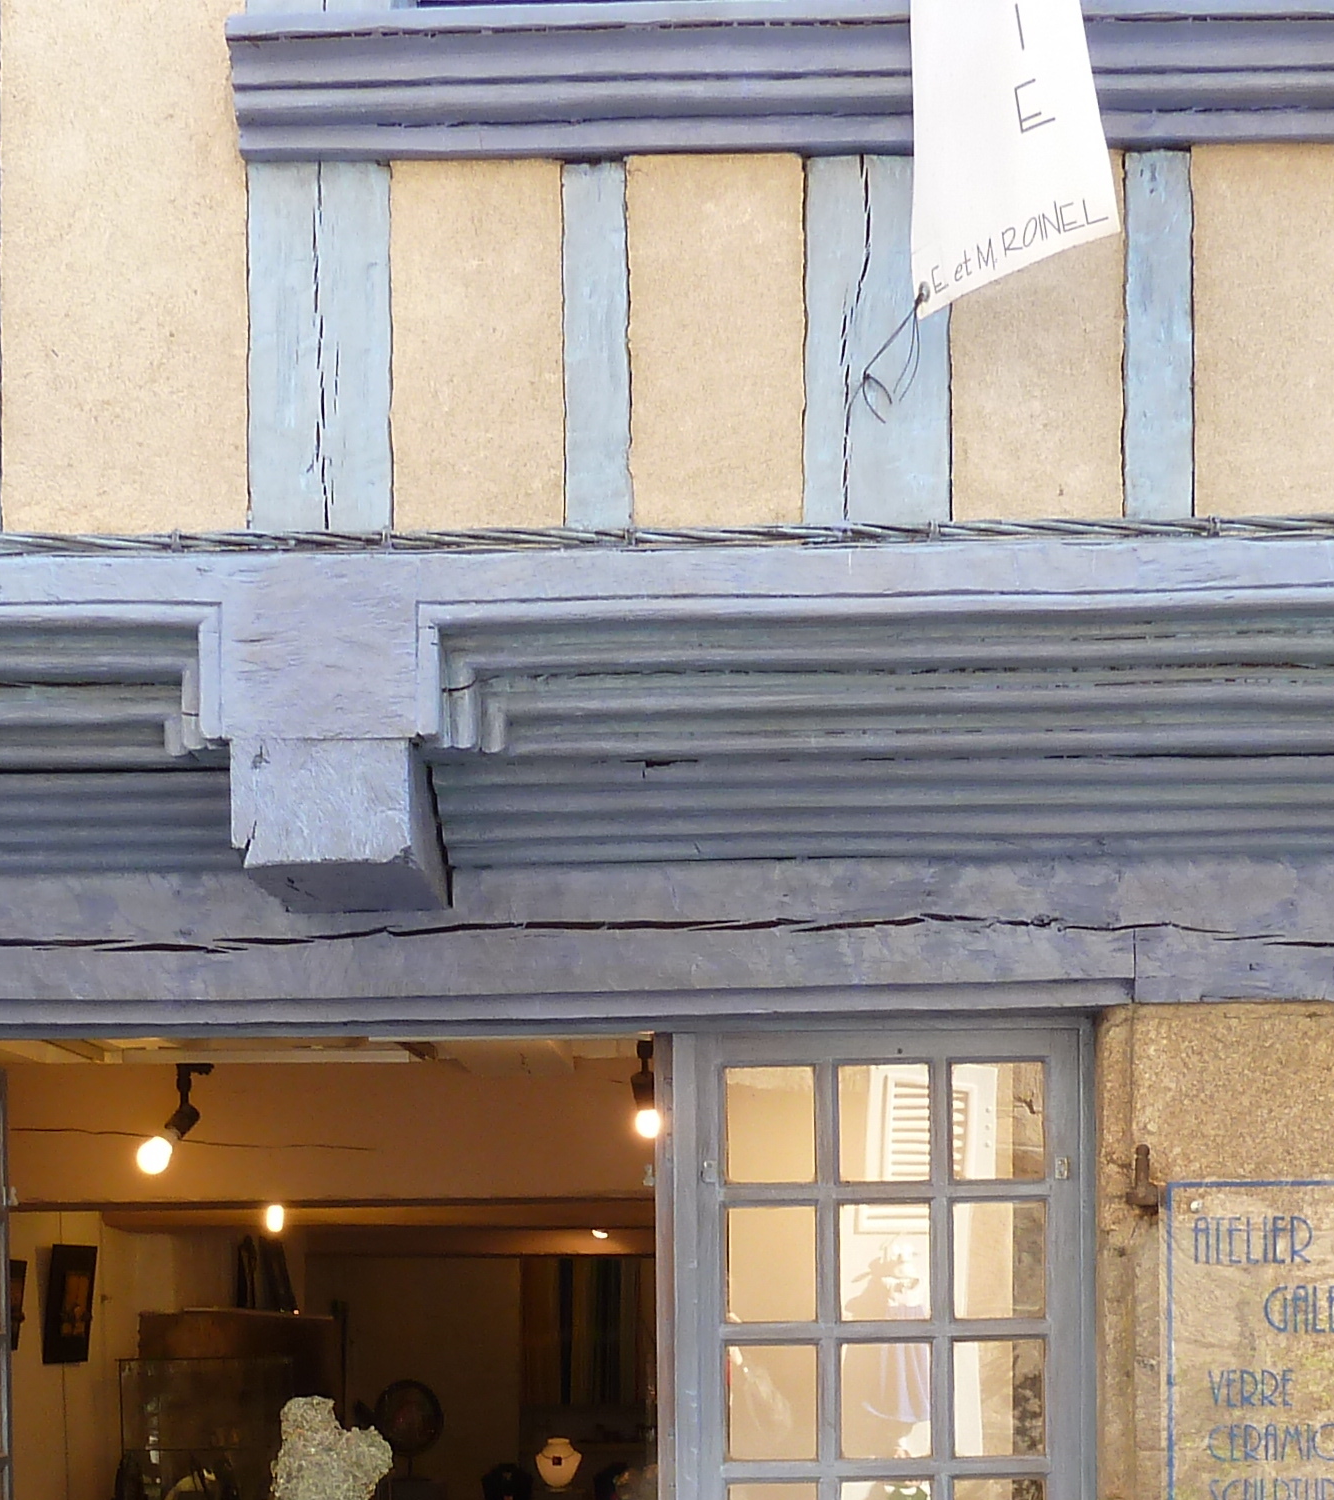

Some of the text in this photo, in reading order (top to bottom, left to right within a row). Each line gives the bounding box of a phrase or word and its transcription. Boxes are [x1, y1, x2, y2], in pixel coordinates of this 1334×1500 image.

[954, 250, 971, 282] et
[1001, 198, 1109, 257] ROINEL
[1192, 1215, 1313, 1265] ATELIER
[1208, 1369, 1294, 1408] VERRE
